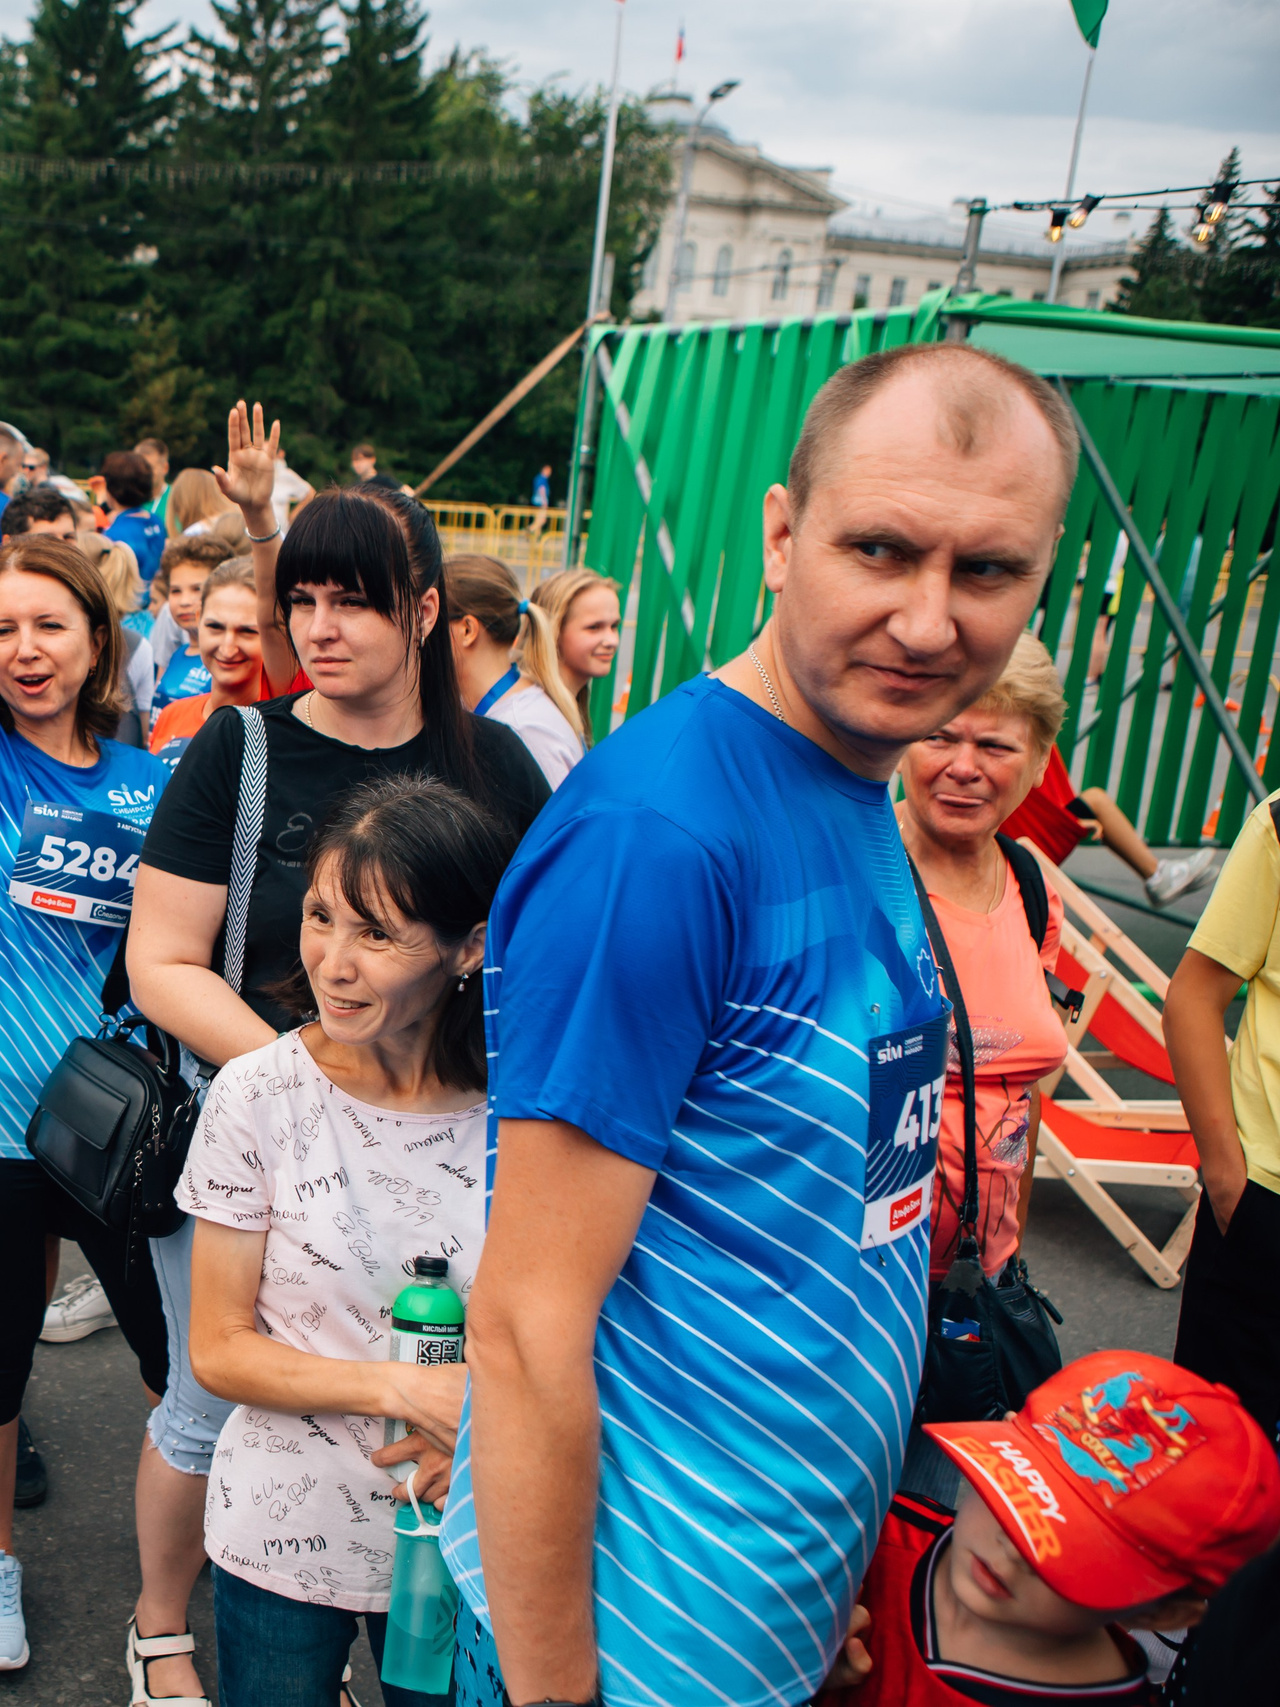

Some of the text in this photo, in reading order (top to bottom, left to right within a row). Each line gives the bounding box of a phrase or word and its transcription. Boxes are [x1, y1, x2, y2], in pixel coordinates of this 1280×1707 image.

[36, 834, 140, 887] 5284
[207, 1179, 256, 1198] Bonjour
[436, 1162, 478, 1188] Bonjour
[302, 1242, 345, 1272] Bonjour
[272, 1267, 309, 1286] Belle
[422, 1324, 447, 1333] КИСЛЫЙ
[301, 1414, 340, 1446] Bonjour
[265, 1435, 304, 1455] Belle
[990, 1440, 1067, 1524] HAPPY
[370, 1491, 397, 1507] Bonj
[952, 1436, 1063, 1563] EASTER
[221, 1545, 271, 1573] Amour
